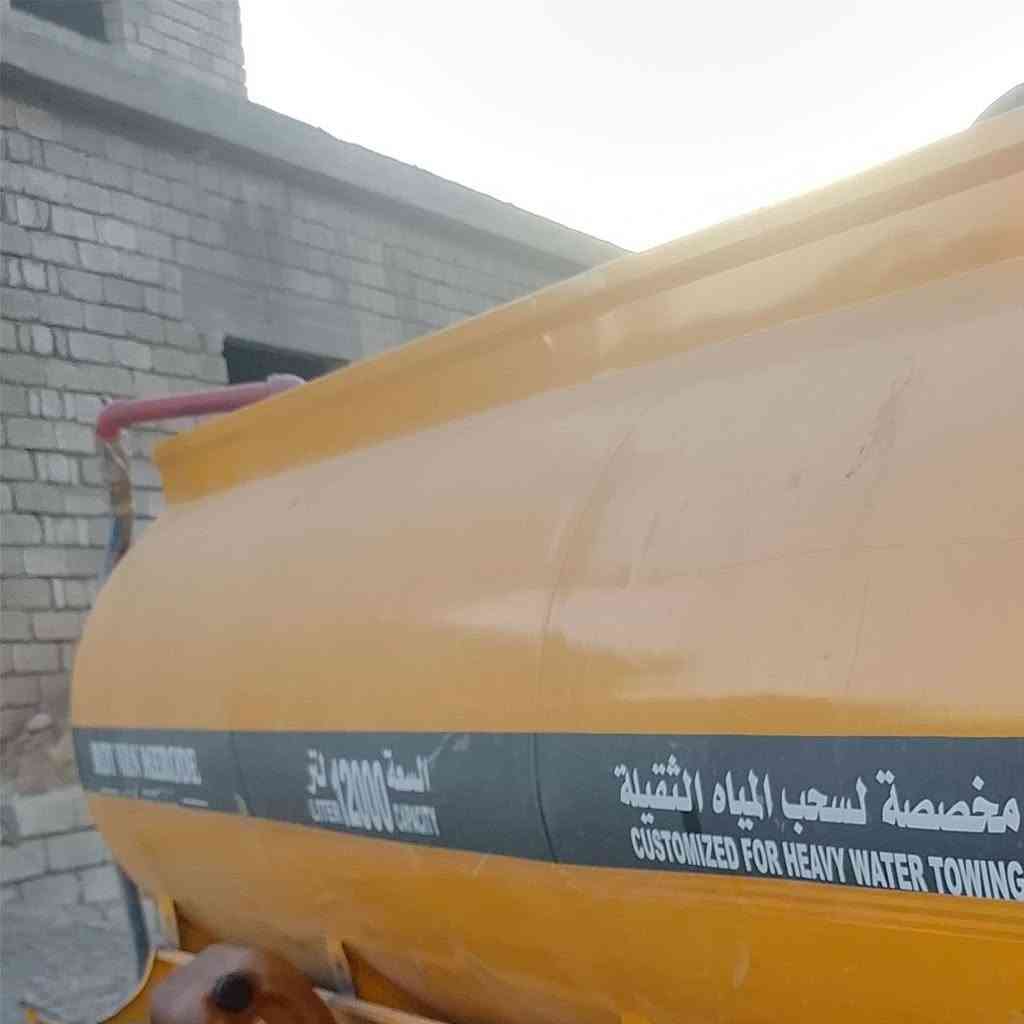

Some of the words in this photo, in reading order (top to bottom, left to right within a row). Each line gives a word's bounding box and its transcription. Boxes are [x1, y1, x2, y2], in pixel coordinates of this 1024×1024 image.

[331, 757, 395, 834] 12000
[614, 754, 703, 825] الثقيلة
[712, 768, 773, 831] المياه
[781, 776, 867, 835] لسحب
[875, 769, 1021, 833] مخصصة
[630, 827, 739, 871] CUSTOMIZED
[740, 838, 784, 875] FOR
[782, 841, 846, 883] HEAVY
[849, 848, 929, 893] WATER
